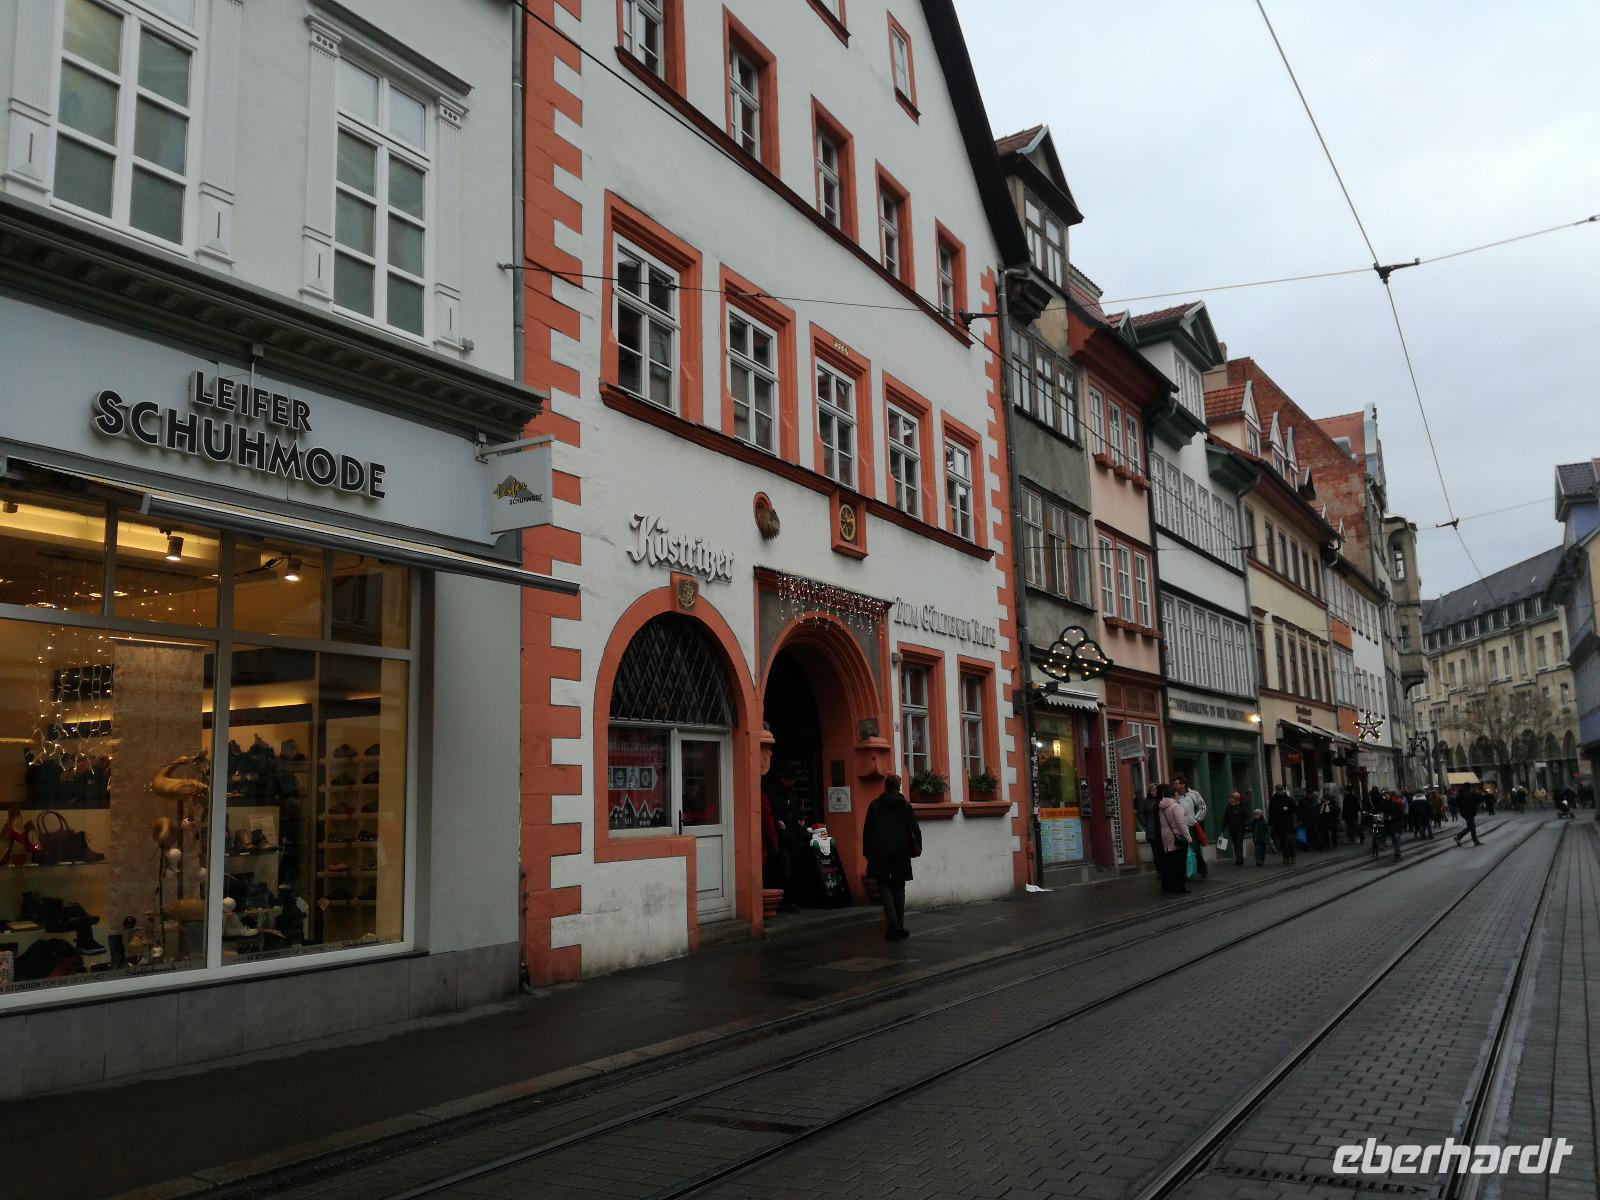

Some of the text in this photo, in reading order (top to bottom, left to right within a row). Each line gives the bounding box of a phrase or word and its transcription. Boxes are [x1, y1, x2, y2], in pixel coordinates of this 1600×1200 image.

[193, 370, 312, 432] LEIFER
[96, 390, 386, 499] SCHUHMODE
[626, 513, 735, 583] Köstritzer
[6, 981, 40, 992] STUNDEN
